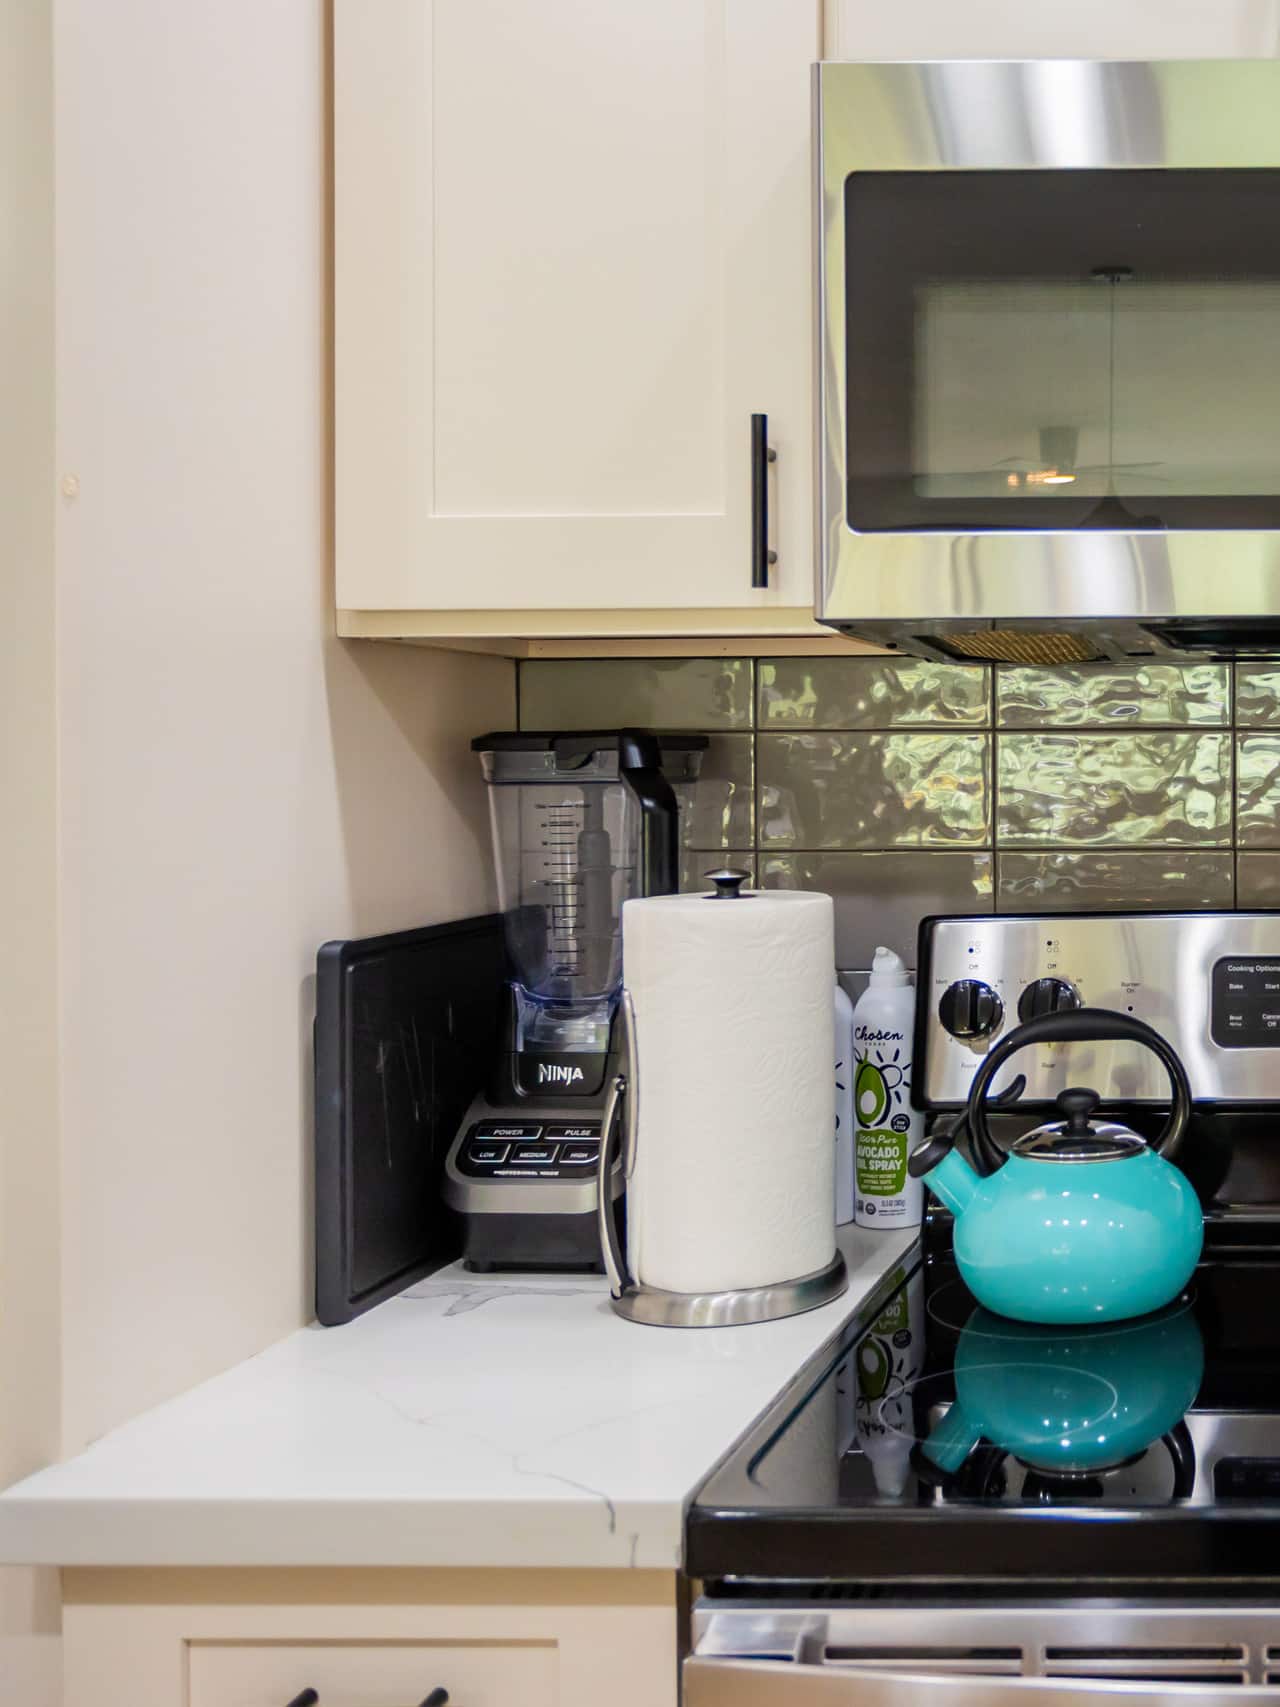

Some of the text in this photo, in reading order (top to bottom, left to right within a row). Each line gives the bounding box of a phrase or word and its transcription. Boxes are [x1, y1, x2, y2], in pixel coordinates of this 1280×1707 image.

[1227, 964, 1280, 973] Cooking Options
[855, 1025, 904, 1041] Chosen
[538, 1063, 584, 1086] NINJA
[493, 1129, 524, 1137] POWER
[564, 1129, 592, 1137] PULSE
[868, 1160, 904, 1171] SPRAY
